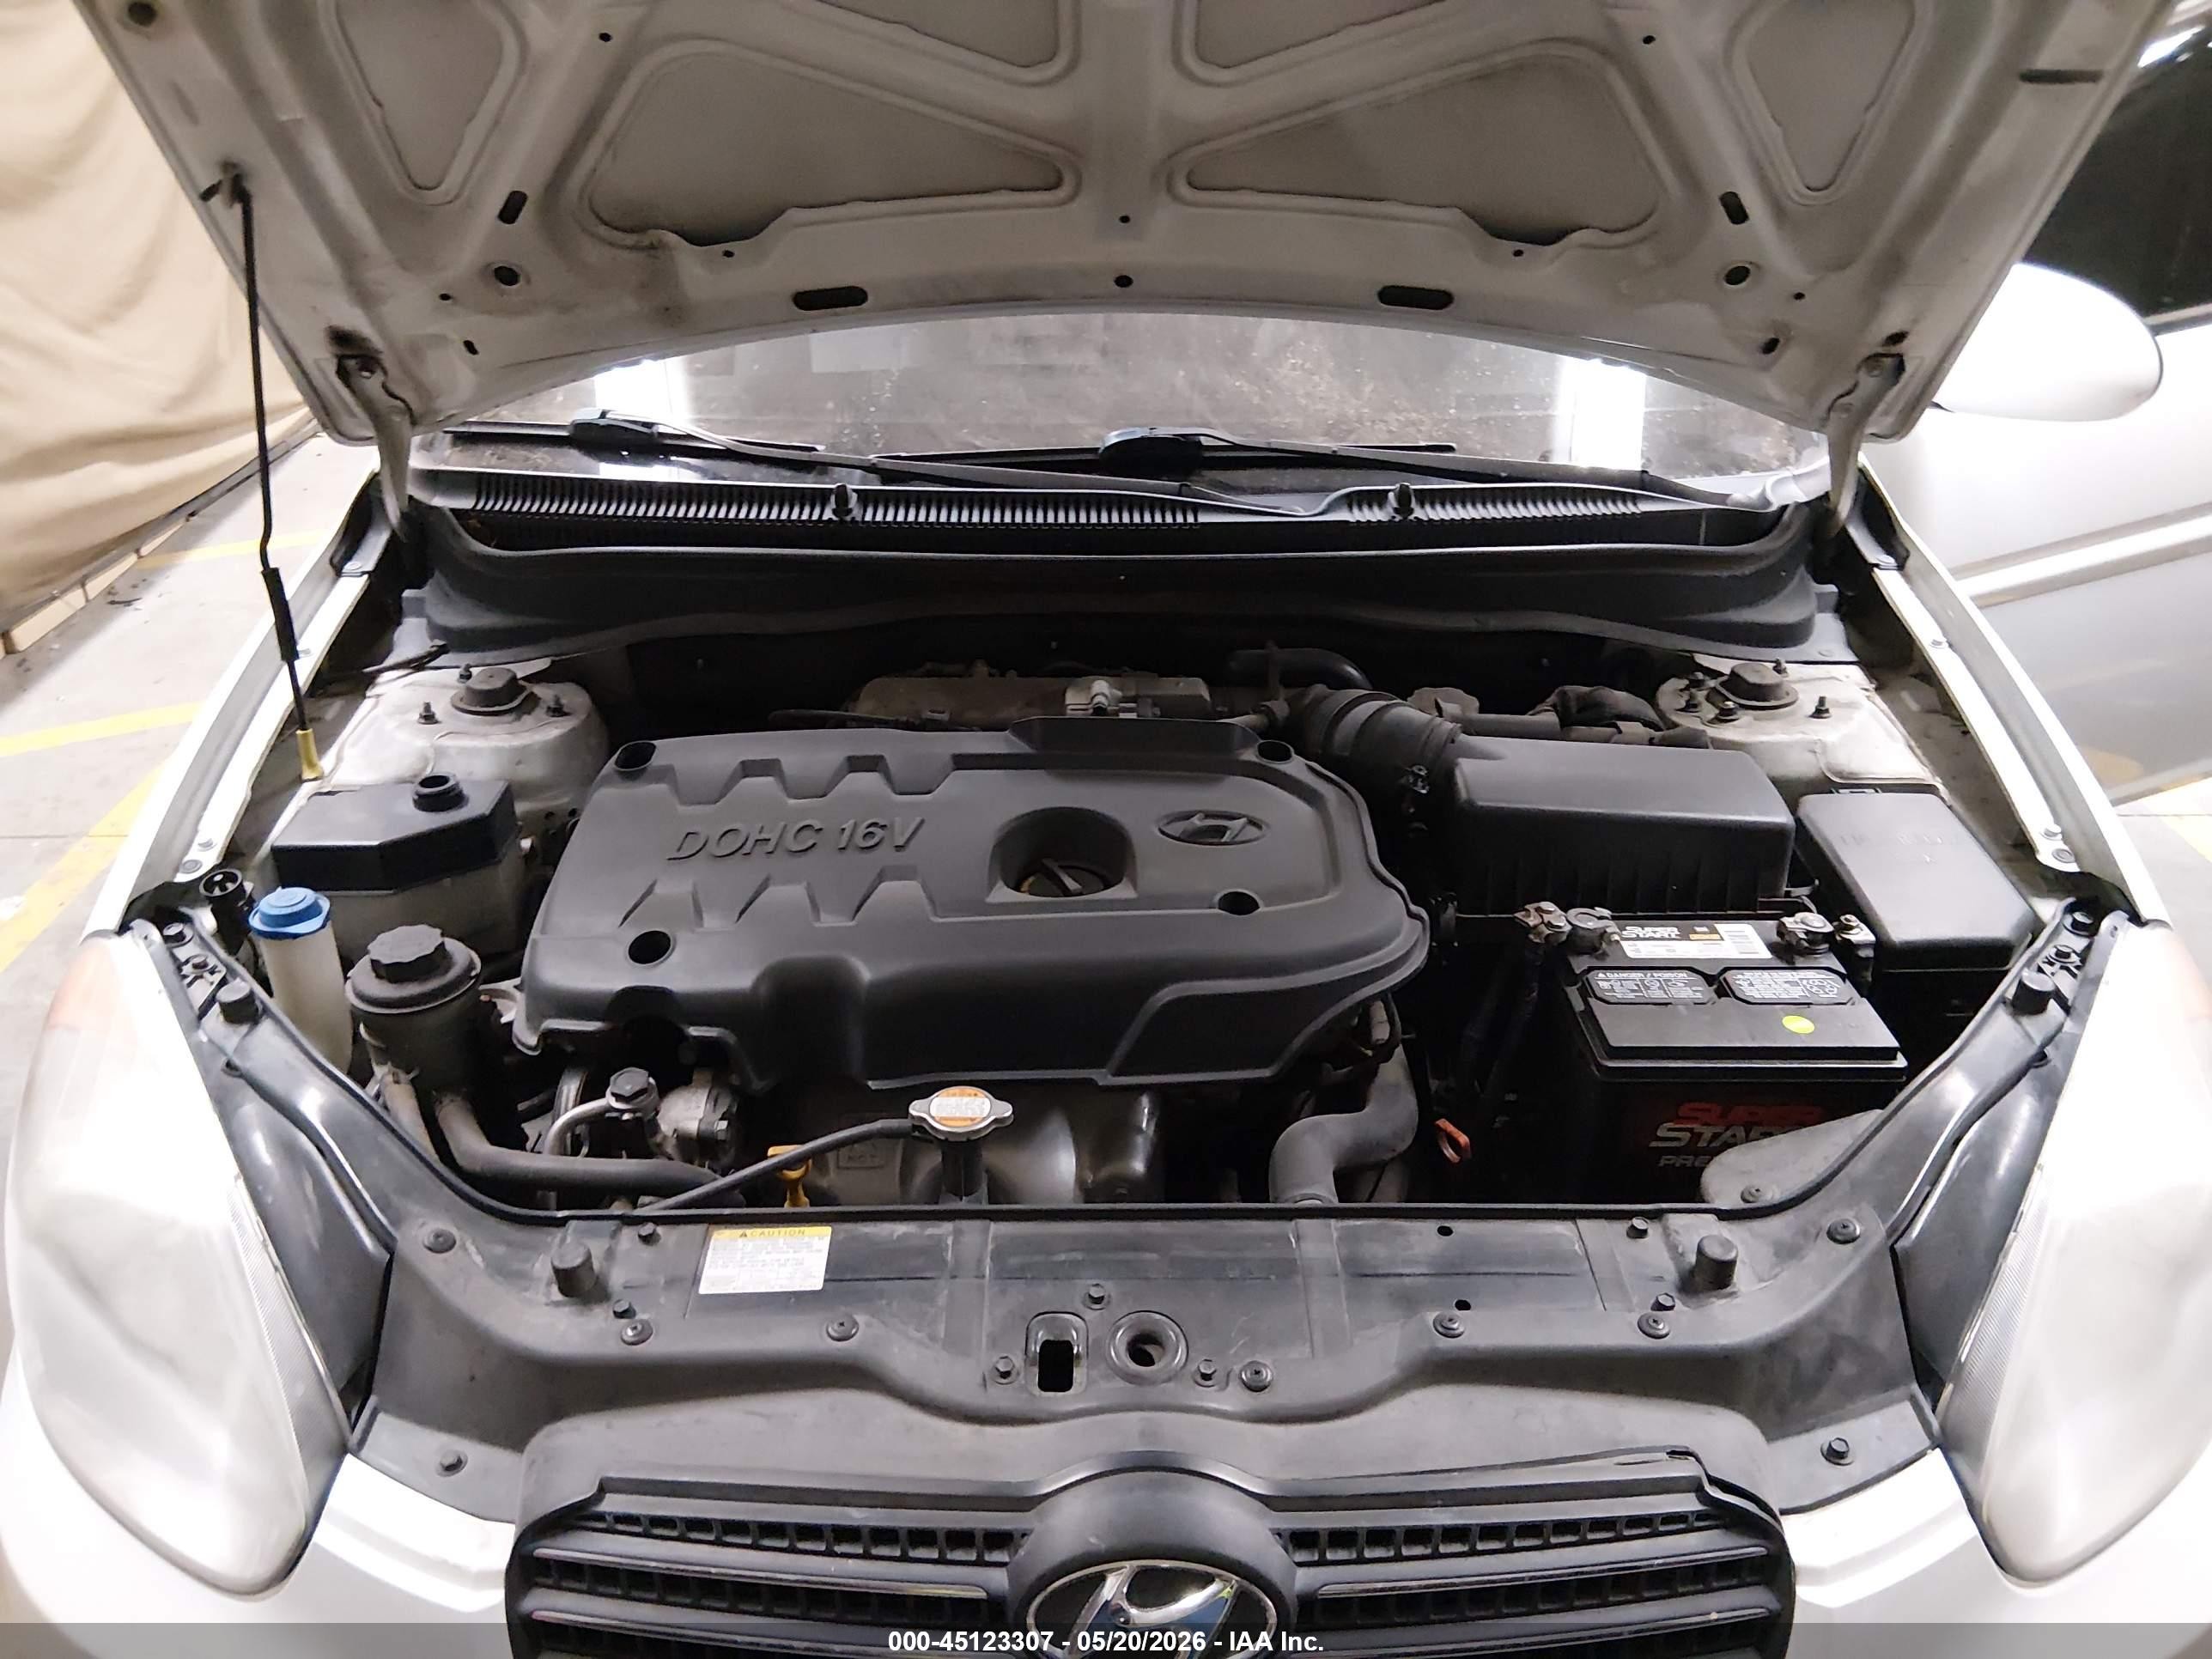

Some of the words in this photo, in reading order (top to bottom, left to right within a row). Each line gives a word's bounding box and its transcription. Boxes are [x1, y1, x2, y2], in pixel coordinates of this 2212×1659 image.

[666, 820, 823, 860] DOHC
[837, 817, 926, 853] 16V
[1621, 930, 1680, 939] START
[1625, 926, 1679, 935] SUPER
[1648, 1122, 1803, 1147] STAR
[1658, 1155, 1714, 1168] PRE
[750, 1229, 805, 1237] CAUTION
